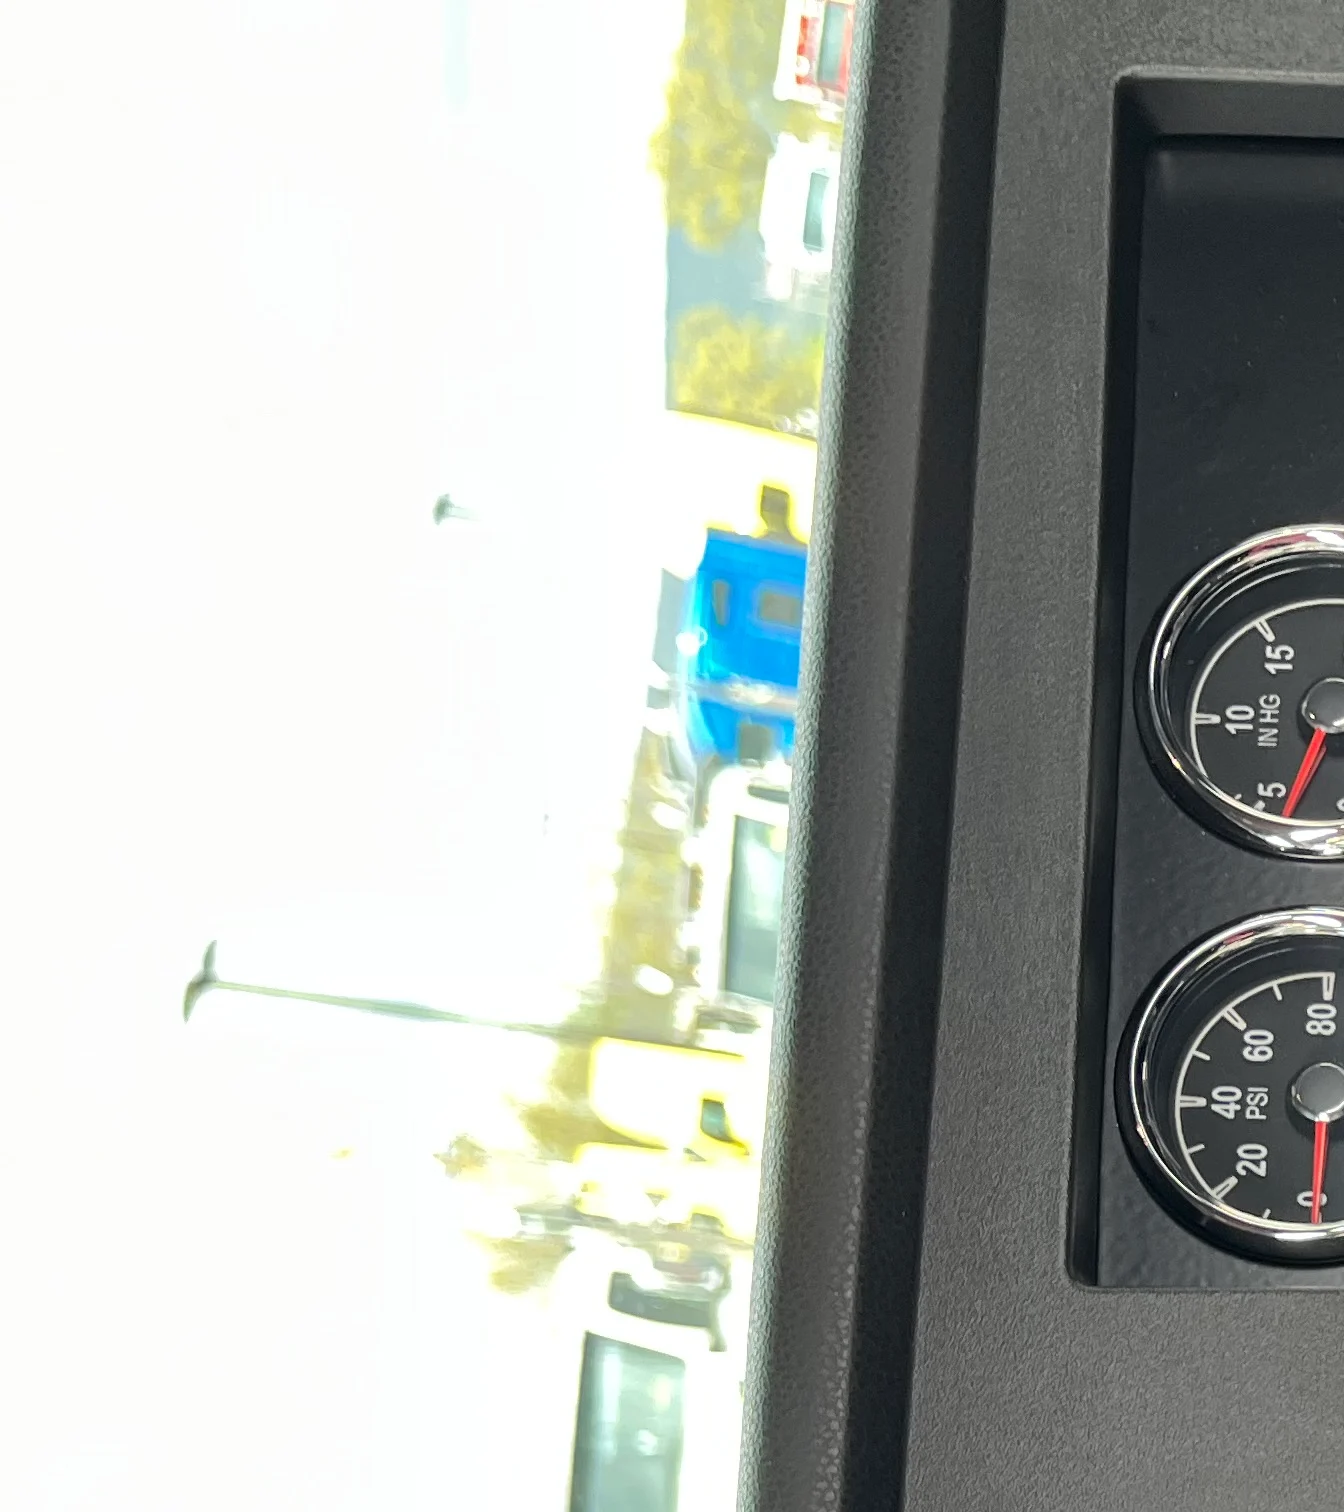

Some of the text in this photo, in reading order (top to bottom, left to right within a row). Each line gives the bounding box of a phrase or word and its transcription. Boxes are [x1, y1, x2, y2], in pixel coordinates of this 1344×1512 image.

[1263, 643, 1295, 675] 15
[1225, 704, 1256, 735] 10
[1258, 693, 1281, 747] IN HG
[1257, 781, 1287, 798] 5
[1305, 1002, 1338, 1037] 80
[1242, 1028, 1275, 1063] 60
[1210, 1085, 1243, 1120] 40
[1245, 1086, 1270, 1121] PSI
[1235, 1142, 1269, 1178] 20
